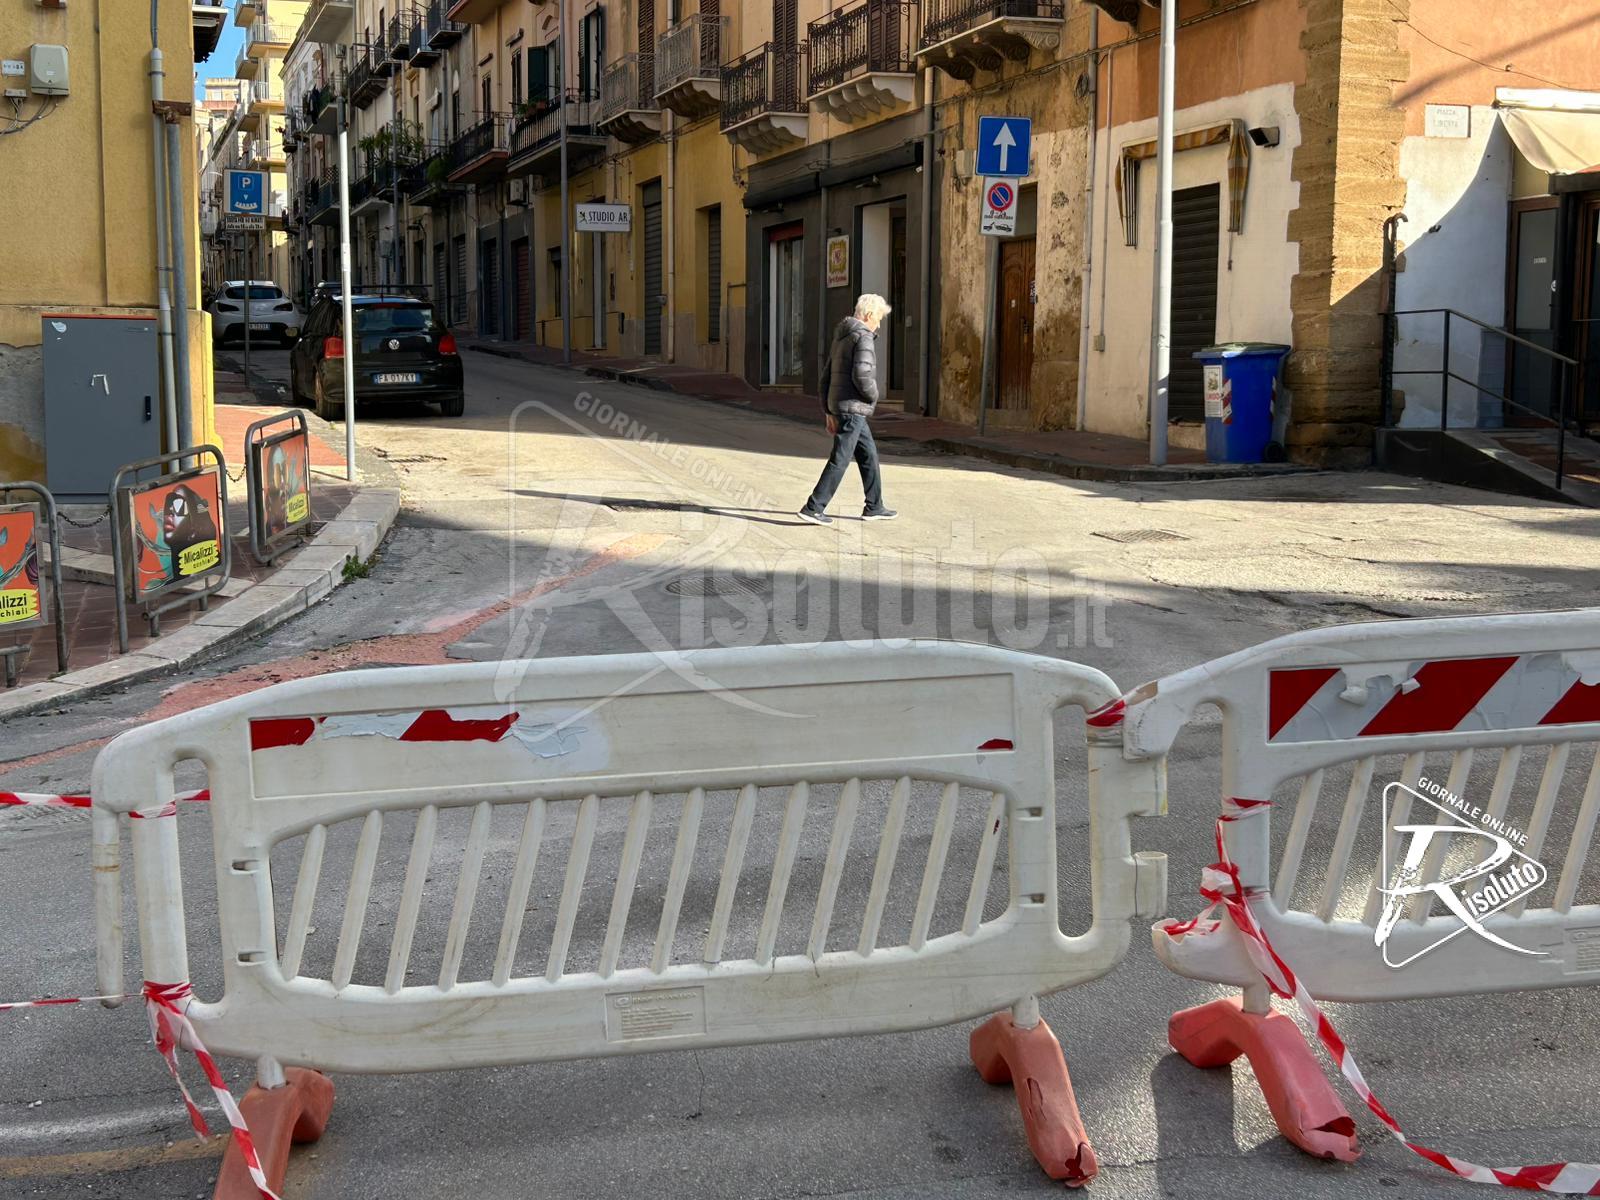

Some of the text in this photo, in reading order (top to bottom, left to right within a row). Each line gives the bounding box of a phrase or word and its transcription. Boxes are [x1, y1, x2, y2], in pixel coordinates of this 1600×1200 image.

[242, 177, 251, 188] P
[589, 211, 615, 222] STUDIO
[183, 543, 214, 565] Micalizzi
